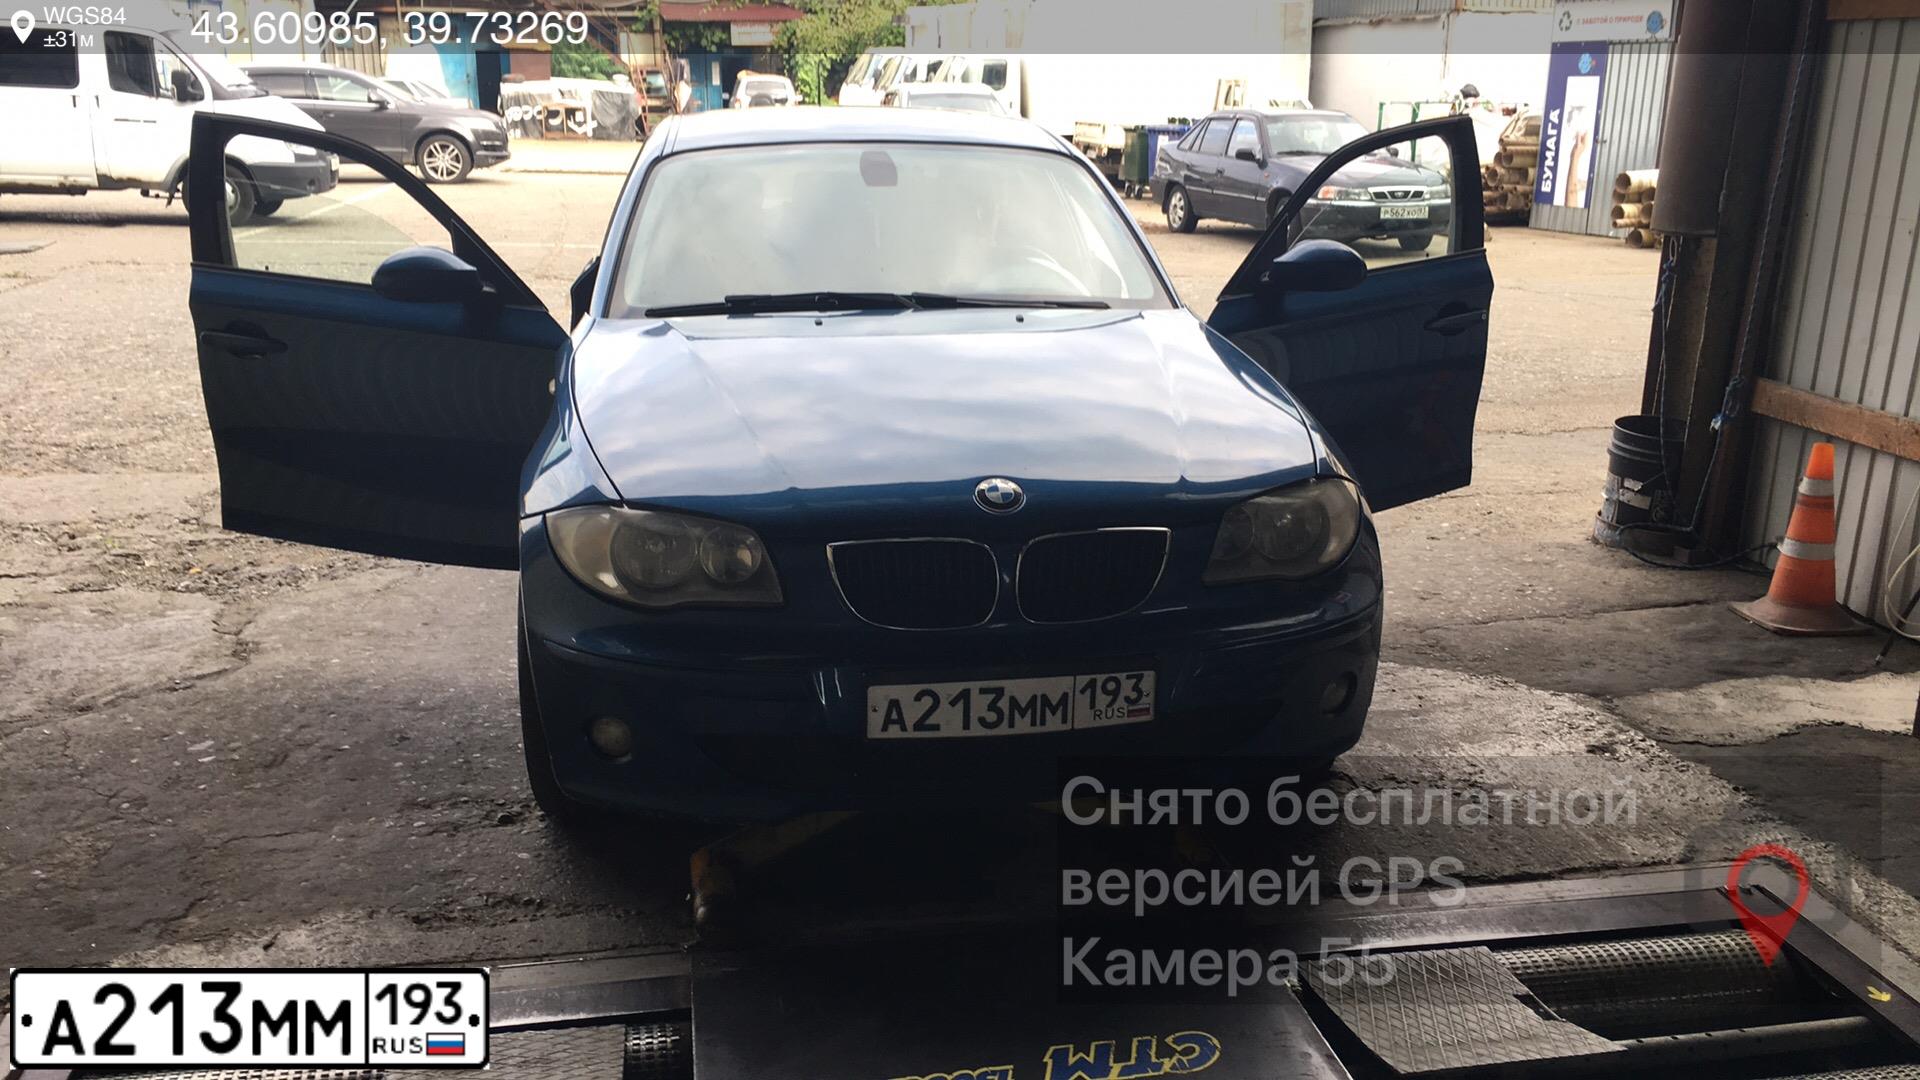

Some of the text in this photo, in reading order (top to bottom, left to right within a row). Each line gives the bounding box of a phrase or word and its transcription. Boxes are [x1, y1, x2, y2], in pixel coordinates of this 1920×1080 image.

[1541, 108, 1560, 193] БУМАГА
[880, 672, 1145, 732] А213ММ 193
[1092, 707, 1126, 721] RUS
